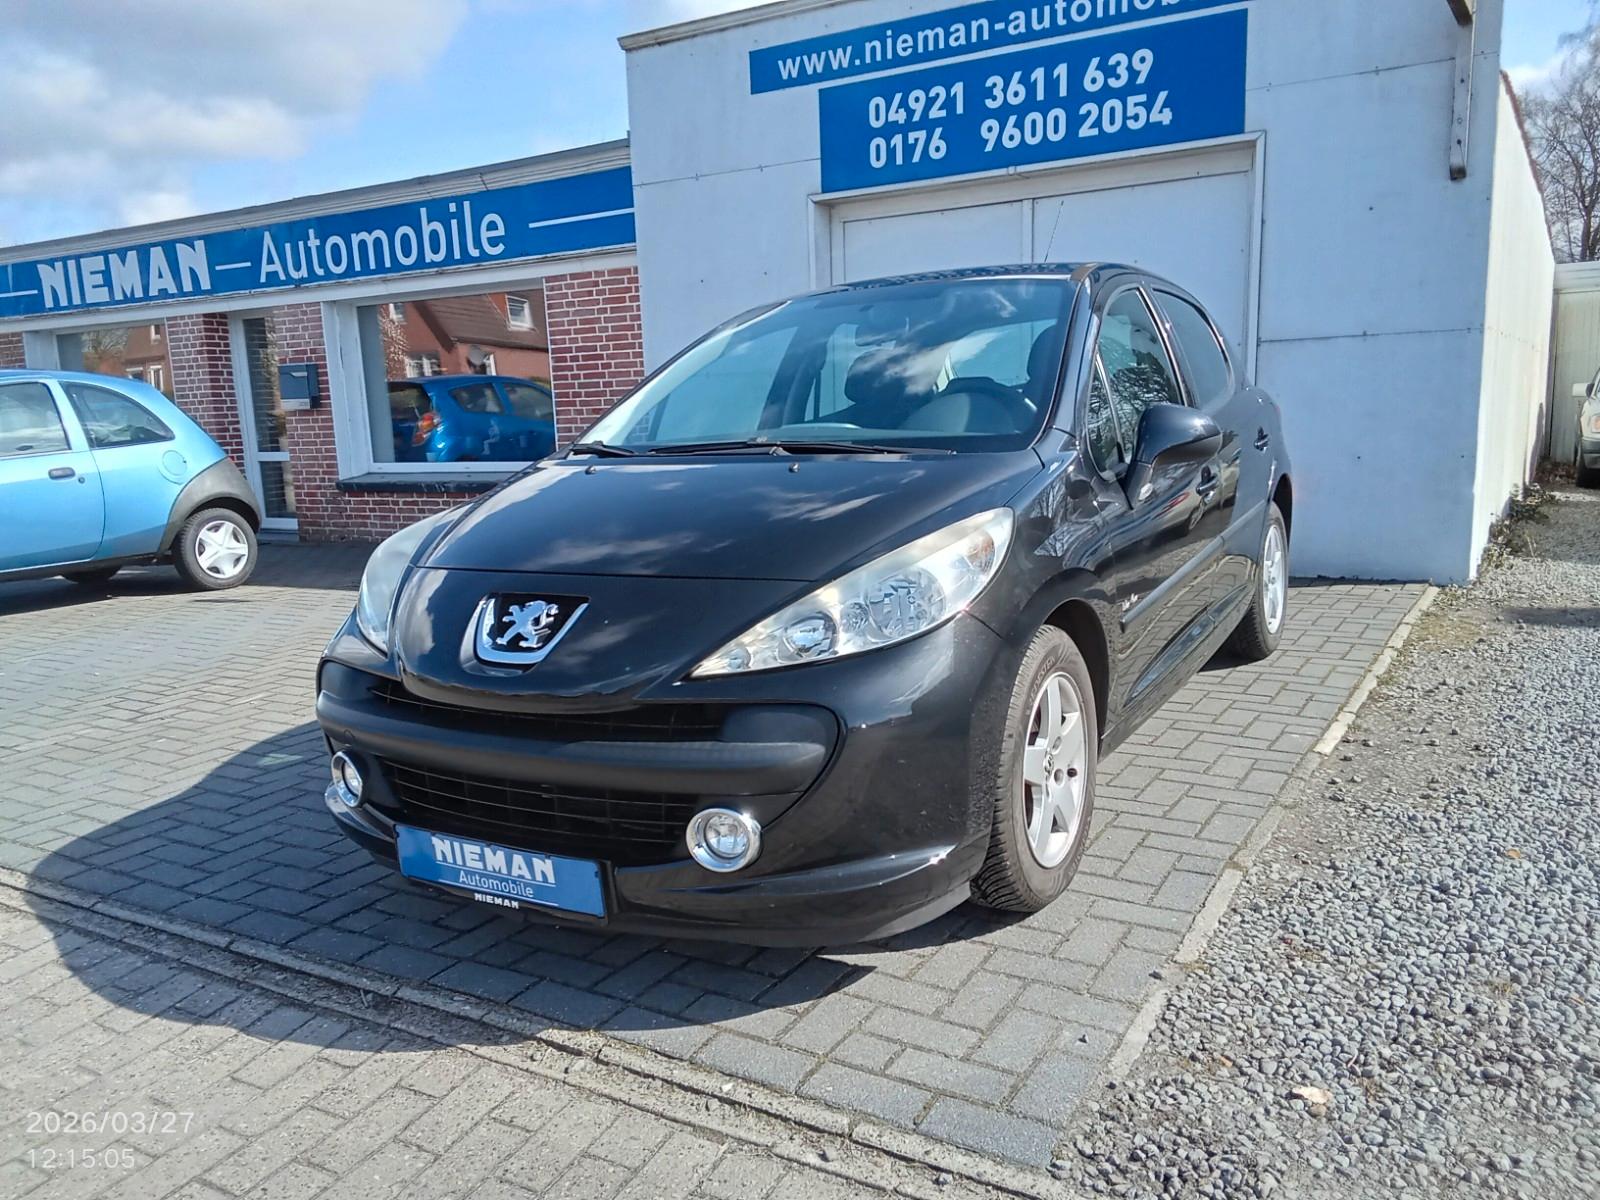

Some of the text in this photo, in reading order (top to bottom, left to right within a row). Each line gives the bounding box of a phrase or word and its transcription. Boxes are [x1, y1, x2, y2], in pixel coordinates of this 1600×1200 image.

[778, 0, 1180, 79] www.nieman-autom
[869, 48, 1154, 128] 04921 3611 639
[870, 91, 1172, 168] 0176 9600 2054
[37, 201, 505, 308] NIEMAN Automobile
[431, 836, 556, 883] NIEMAN
[459, 870, 534, 897] Automobile
[474, 893, 519, 909] NIEMAN
